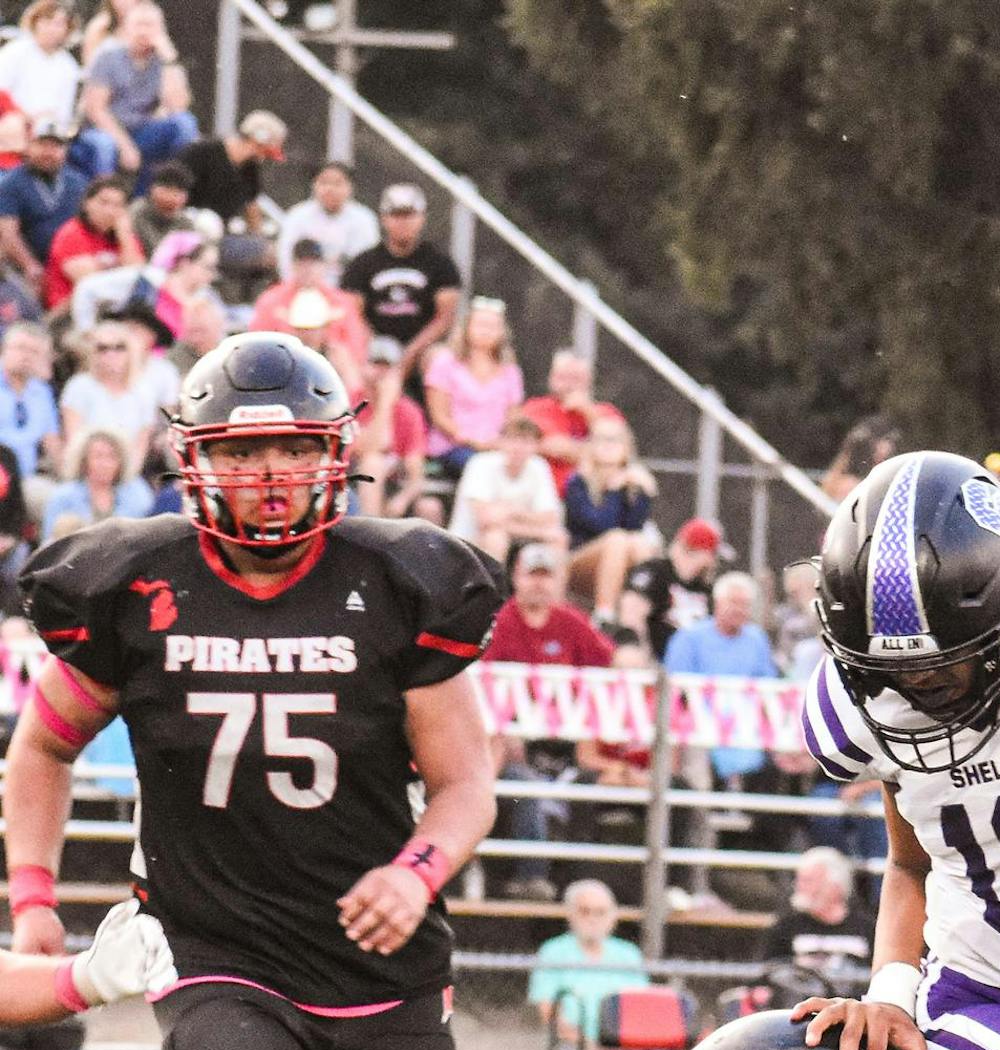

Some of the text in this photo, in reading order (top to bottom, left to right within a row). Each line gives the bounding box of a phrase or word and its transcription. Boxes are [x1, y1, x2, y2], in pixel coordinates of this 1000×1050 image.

[164, 635, 358, 673] PIRATES
[881, 638, 904, 650] ALL
[186, 692, 339, 809] 75
